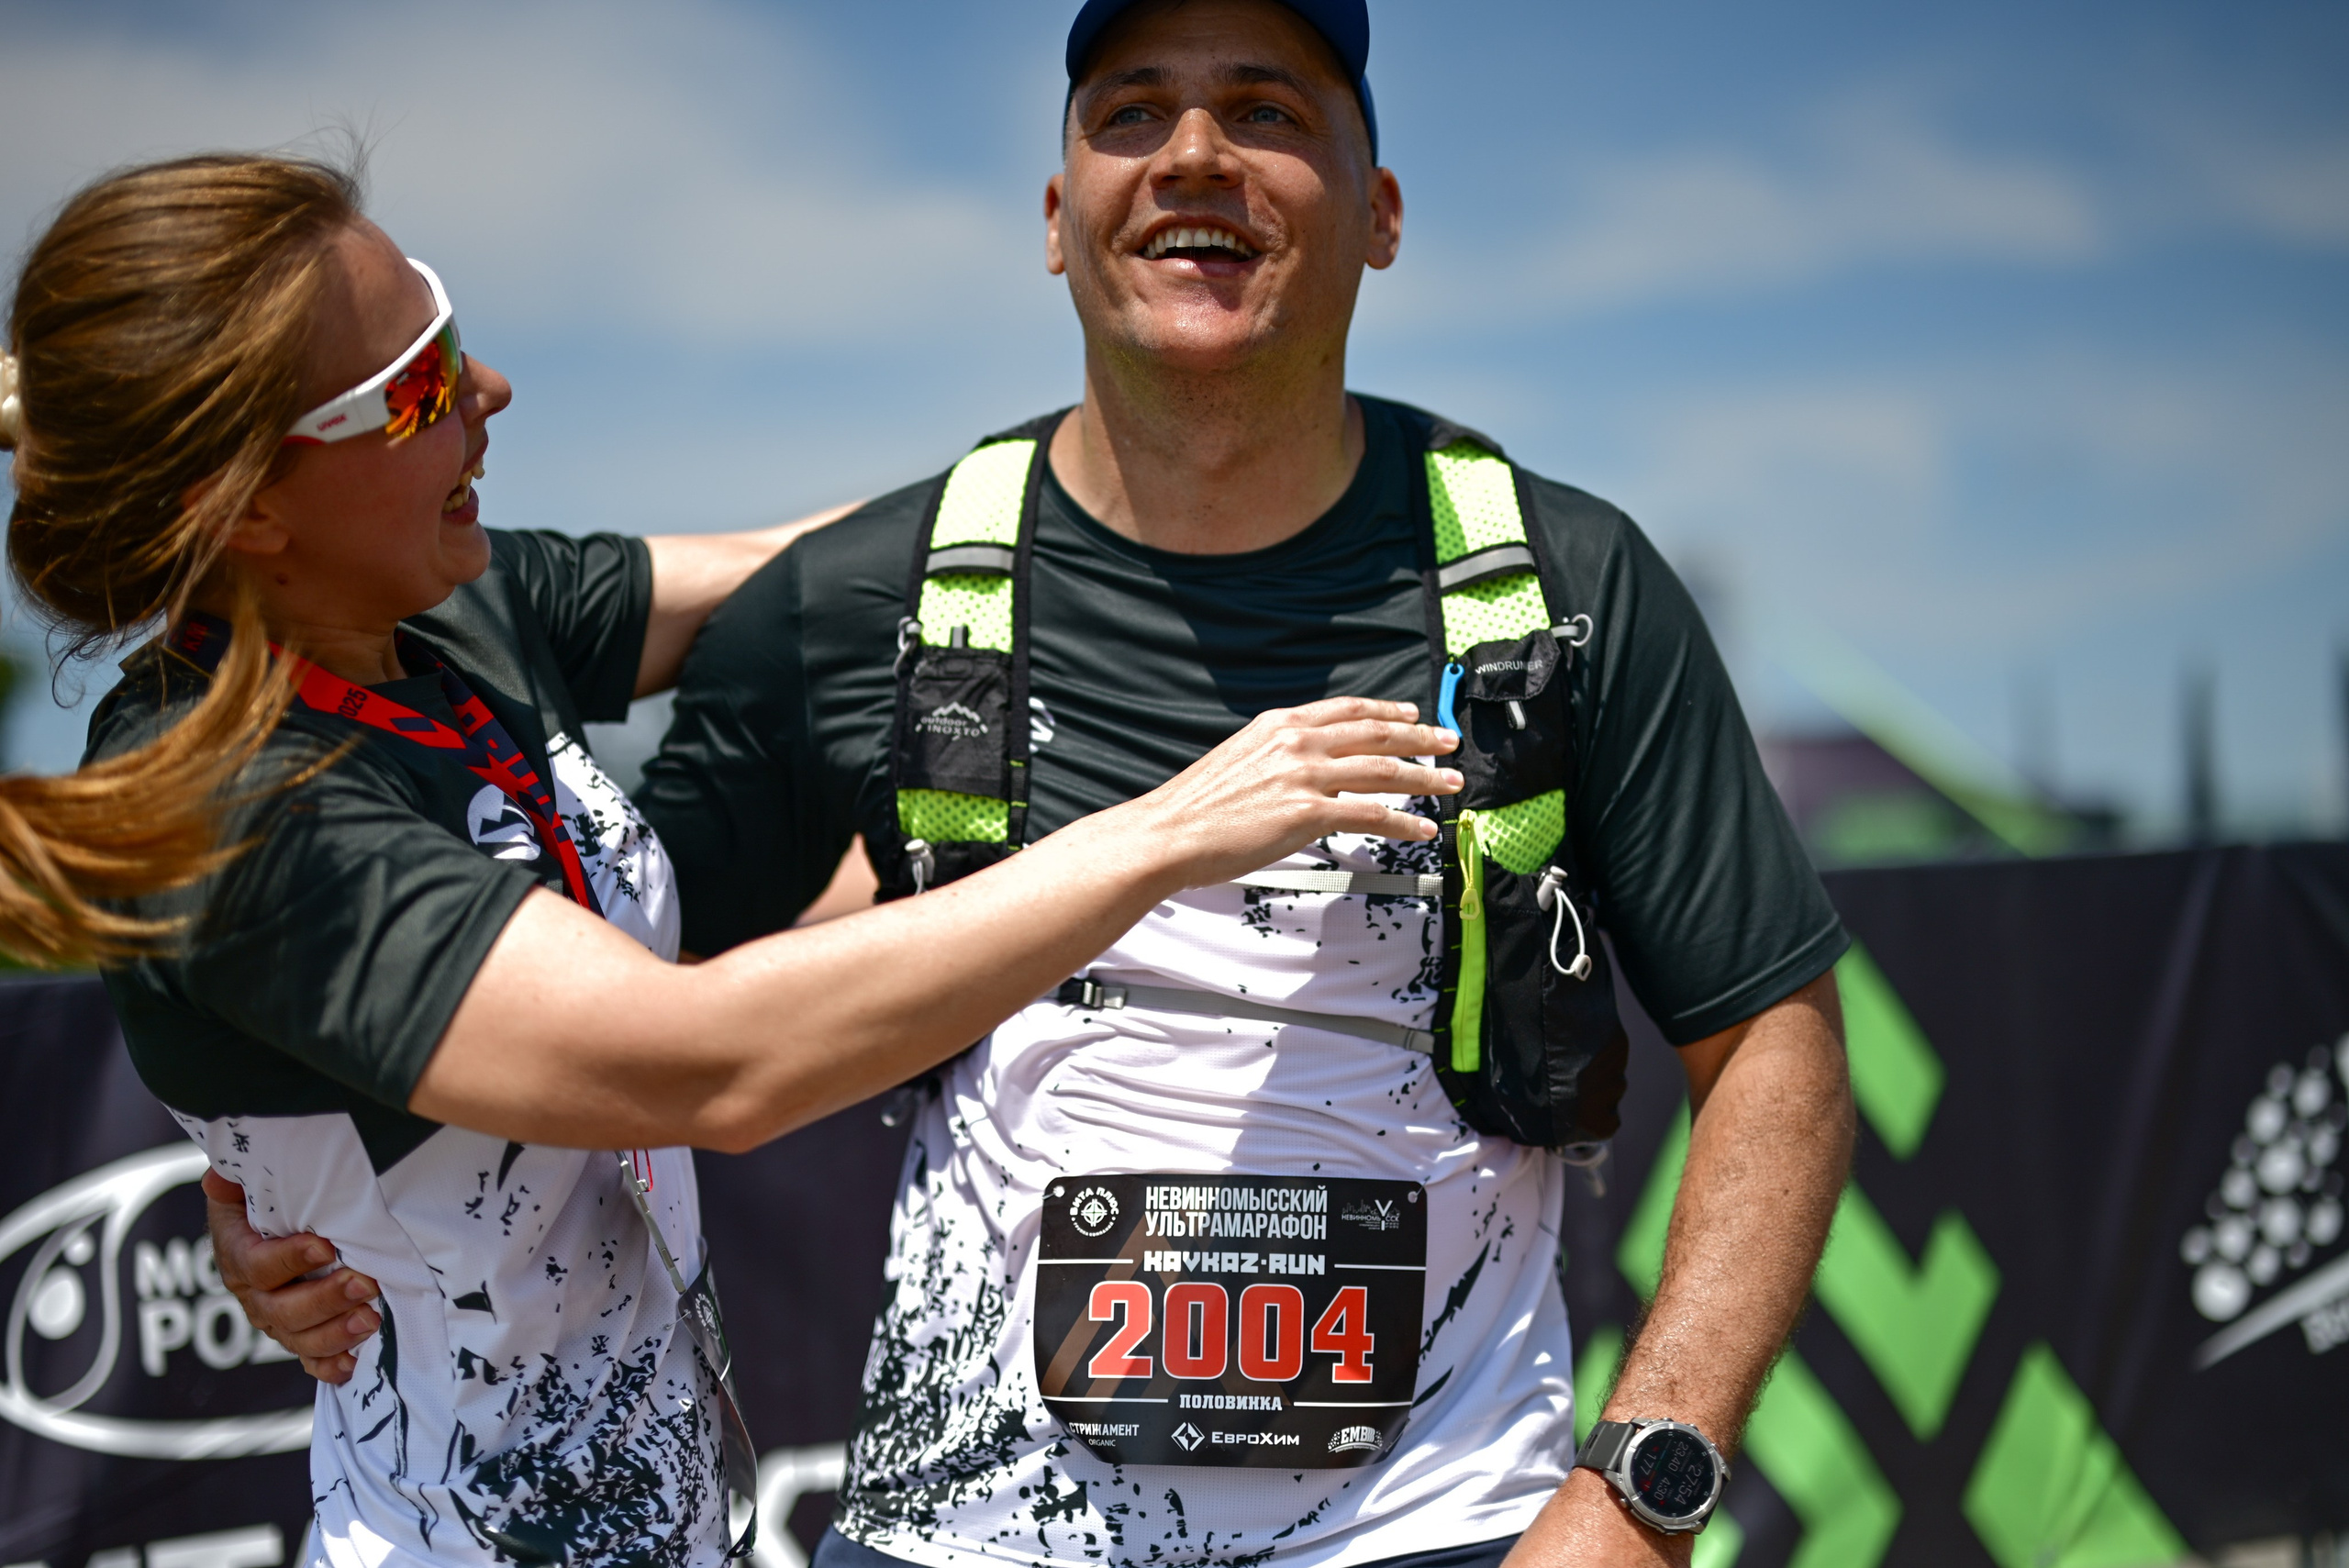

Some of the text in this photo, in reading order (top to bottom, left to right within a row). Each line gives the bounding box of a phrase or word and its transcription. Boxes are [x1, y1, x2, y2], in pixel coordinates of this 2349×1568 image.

[338, 687, 367, 717] 025
[1145, 1185, 1328, 1213] НЕВИННОМЫССКИЙ
[1145, 1210, 1328, 1240] УЛЬТРАМАРАФОН
[1087, 1280, 1375, 1385] 2004
[1179, 1394, 1283, 1411] ПОЛОВИНКА
[1068, 1421, 1140, 1437] СТРИЖАМЕНТ
[1088, 1439, 1117, 1448] ORGANIC
